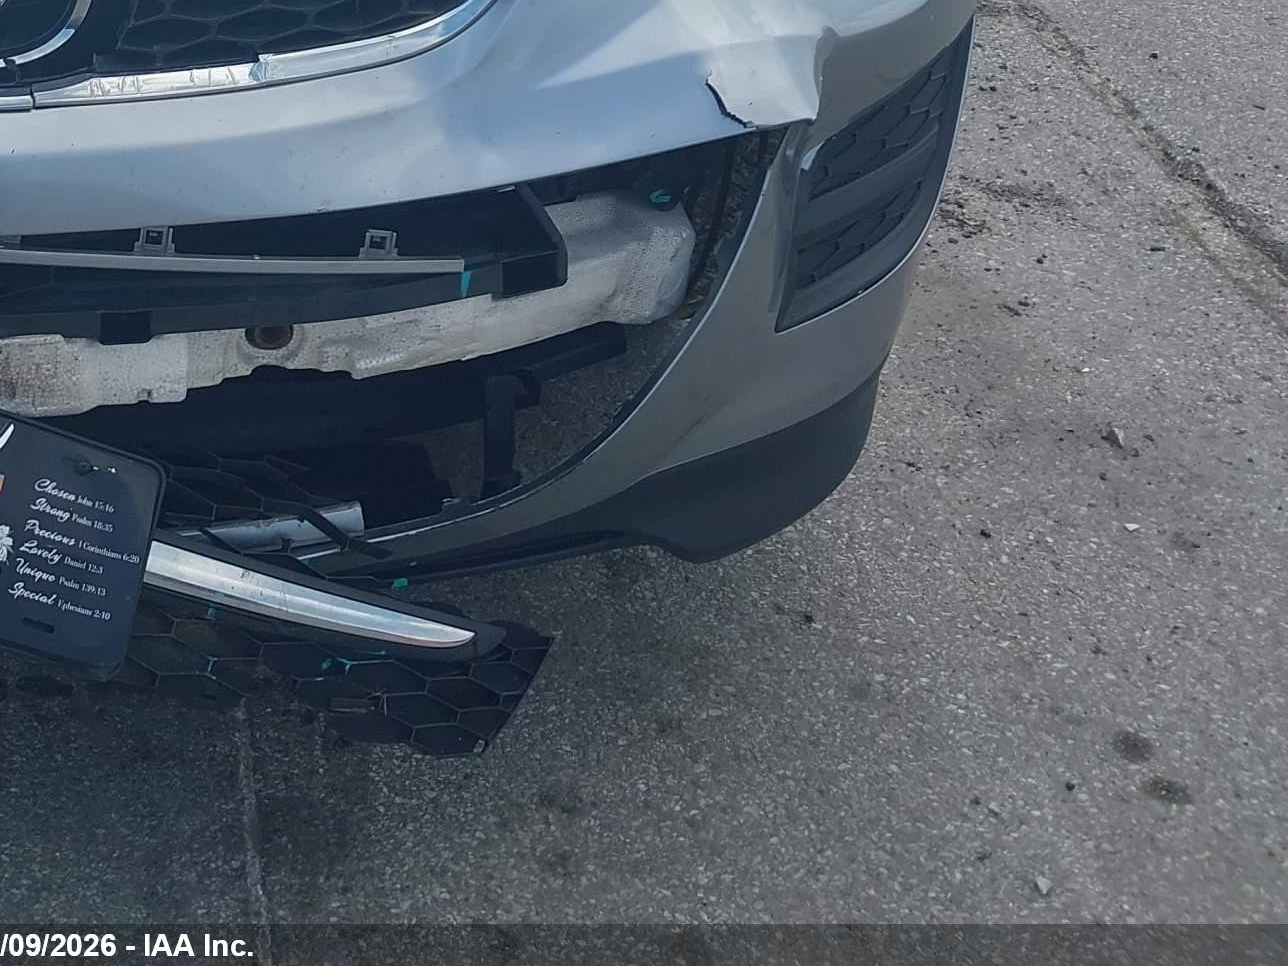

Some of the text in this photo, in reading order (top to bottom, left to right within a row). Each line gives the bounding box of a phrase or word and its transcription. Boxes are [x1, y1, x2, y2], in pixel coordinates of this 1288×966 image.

[34, 478, 115, 513] Chosen John 15:16
[30, 498, 113, 532] Strong Psalm 18:35
[19, 540, 103, 574] Lovely Daniel 12:3
[24, 519, 75, 545] Precious
[82, 542, 122, 560] Corinthians
[123, 553, 140, 564] 6:20
[16, 558, 56, 582] Unique
[59, 577, 79, 590] Psalm
[8, 582, 111, 621] Special Ephesians 2:10
